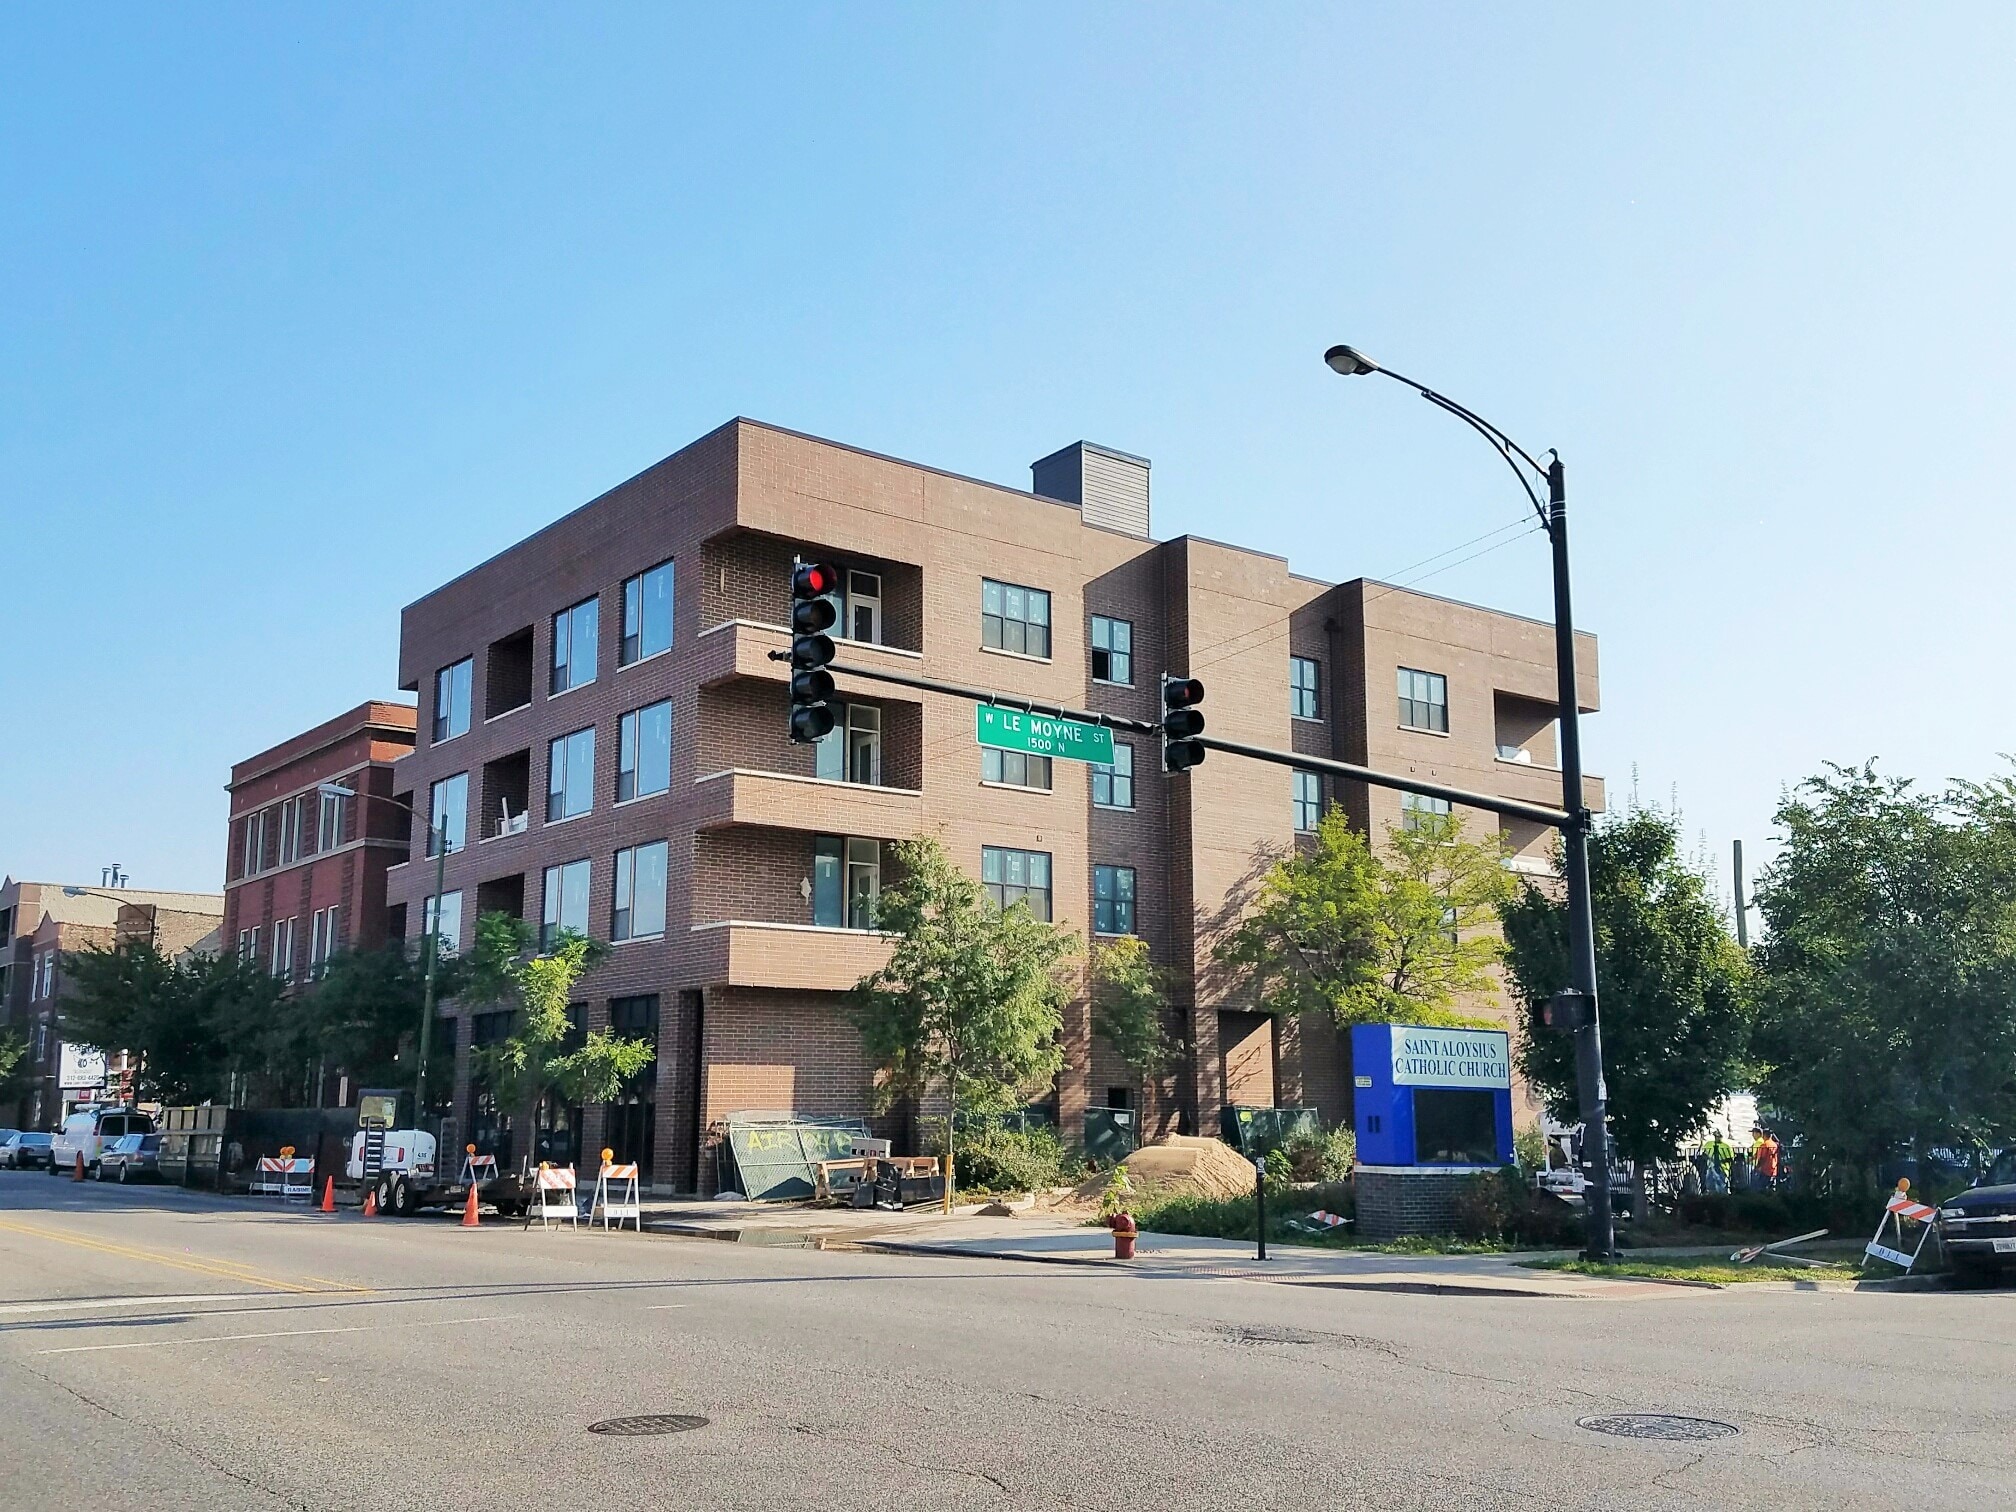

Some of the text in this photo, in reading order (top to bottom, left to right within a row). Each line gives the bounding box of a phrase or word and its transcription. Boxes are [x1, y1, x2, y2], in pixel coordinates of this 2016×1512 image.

[985, 712, 1105, 744] W LE MOYNE ST
[1028, 737, 1065, 753] 1500 N
[1405, 1038, 1497, 1059] SAINT ALOYSIUS
[1395, 1057, 1506, 1078] CATHOLIC CHURCH
[747, 1129, 800, 1153] AIR
